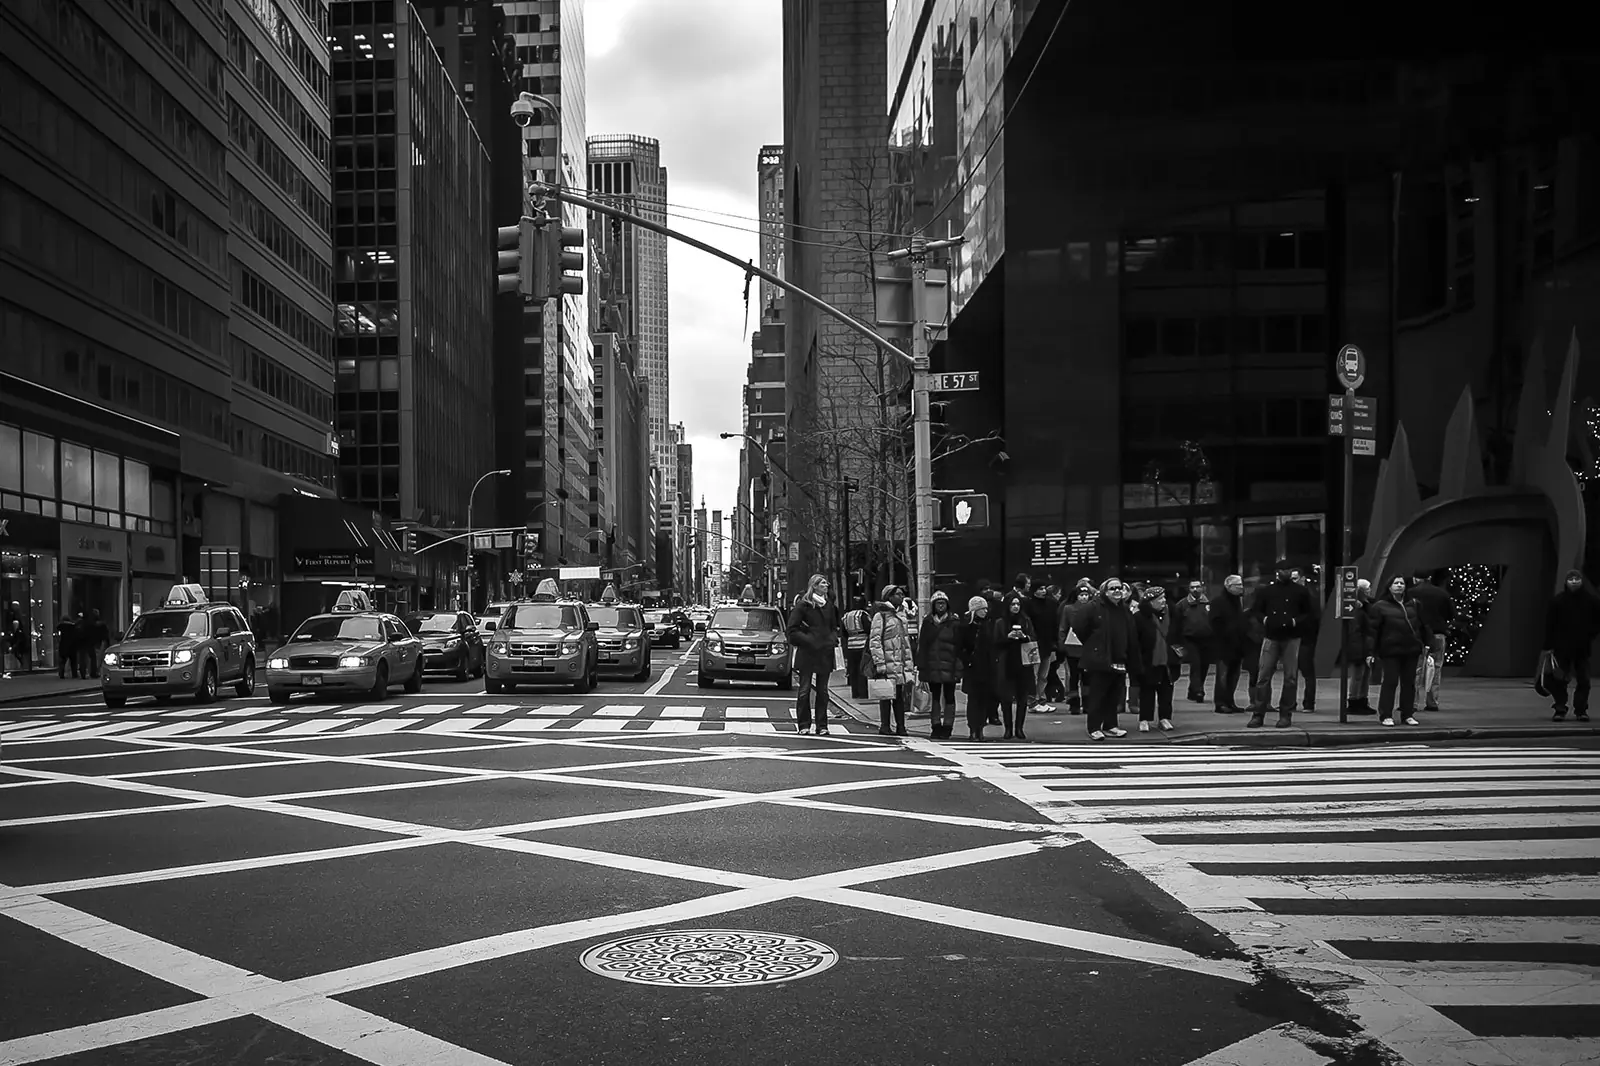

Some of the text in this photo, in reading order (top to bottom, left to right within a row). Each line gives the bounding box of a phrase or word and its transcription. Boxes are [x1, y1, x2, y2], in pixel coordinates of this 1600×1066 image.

[943, 374, 978, 389] E 57 ST
[1031, 531, 1099, 566] IBM
